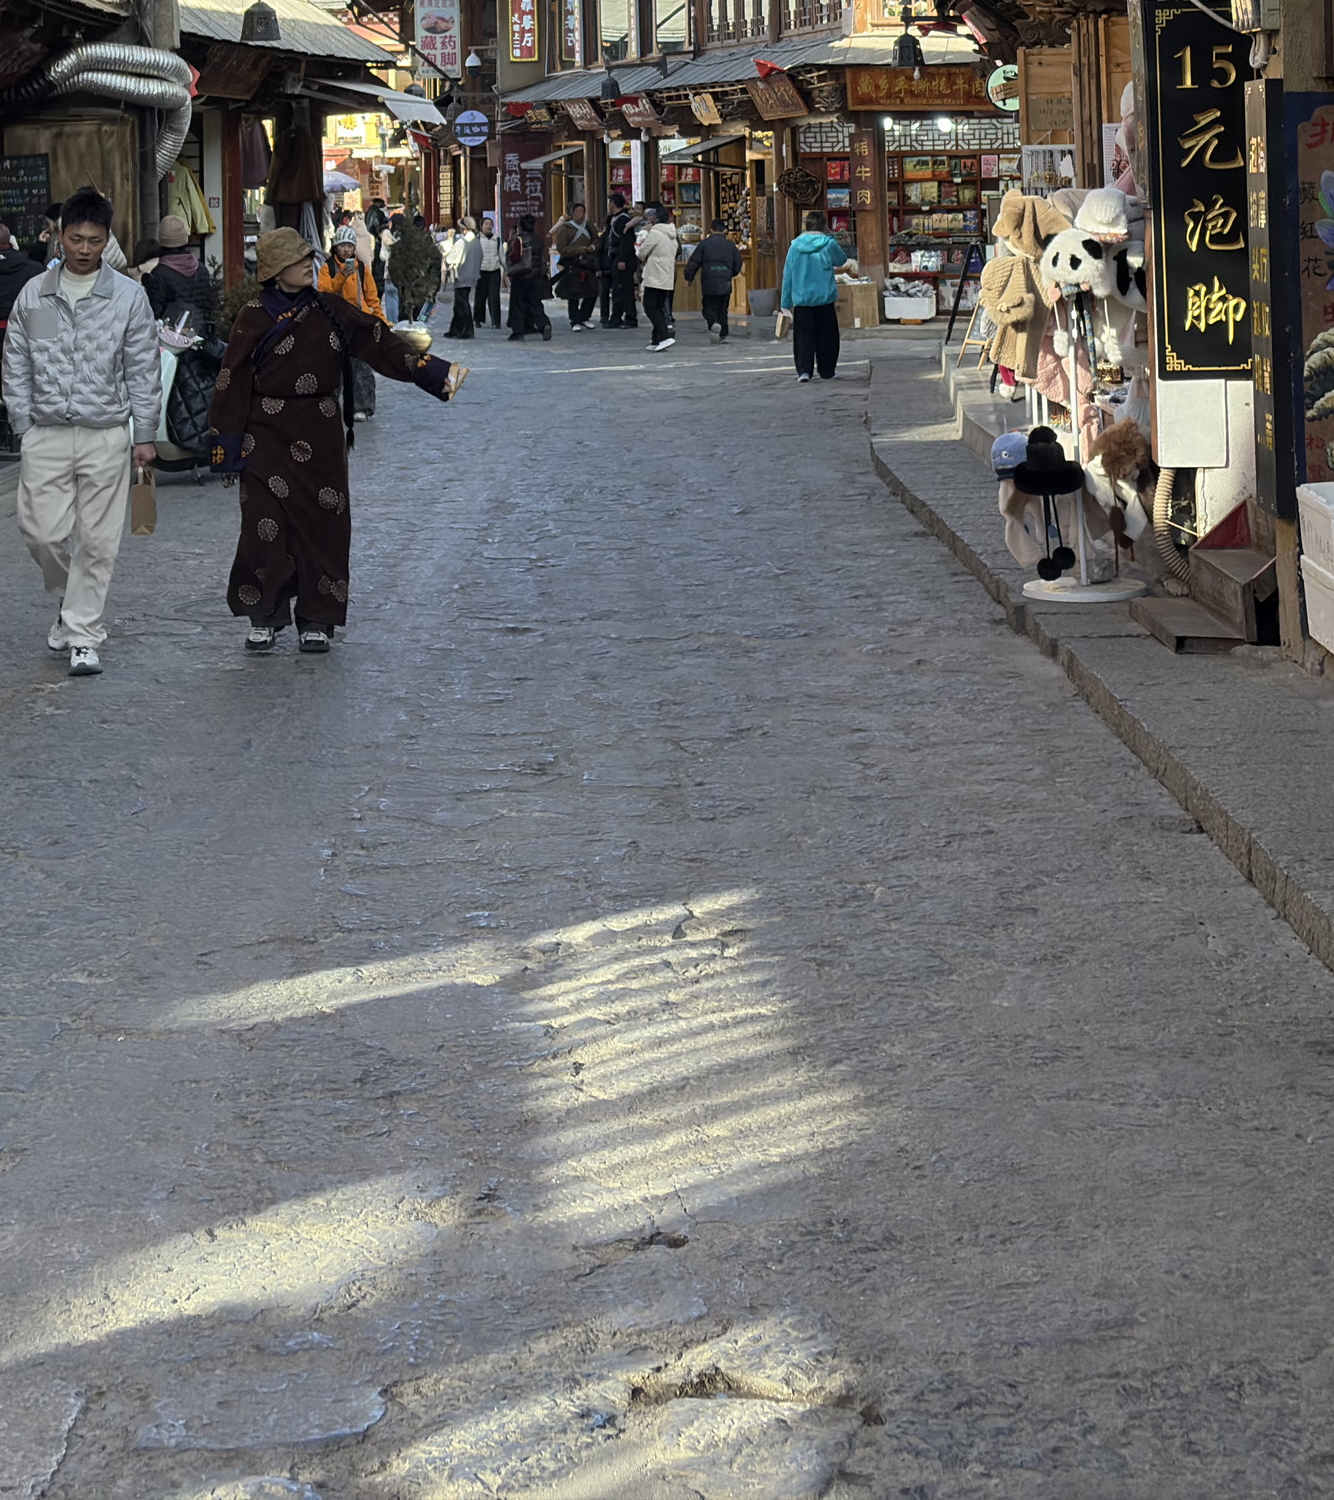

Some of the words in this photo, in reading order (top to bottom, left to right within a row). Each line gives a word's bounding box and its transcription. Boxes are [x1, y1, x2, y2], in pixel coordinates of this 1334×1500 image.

[421, 36, 457, 51] 藏药
[854, 141, 872, 206] 牦牛肉
[1172, 44, 1247, 346] 15元泡脚
